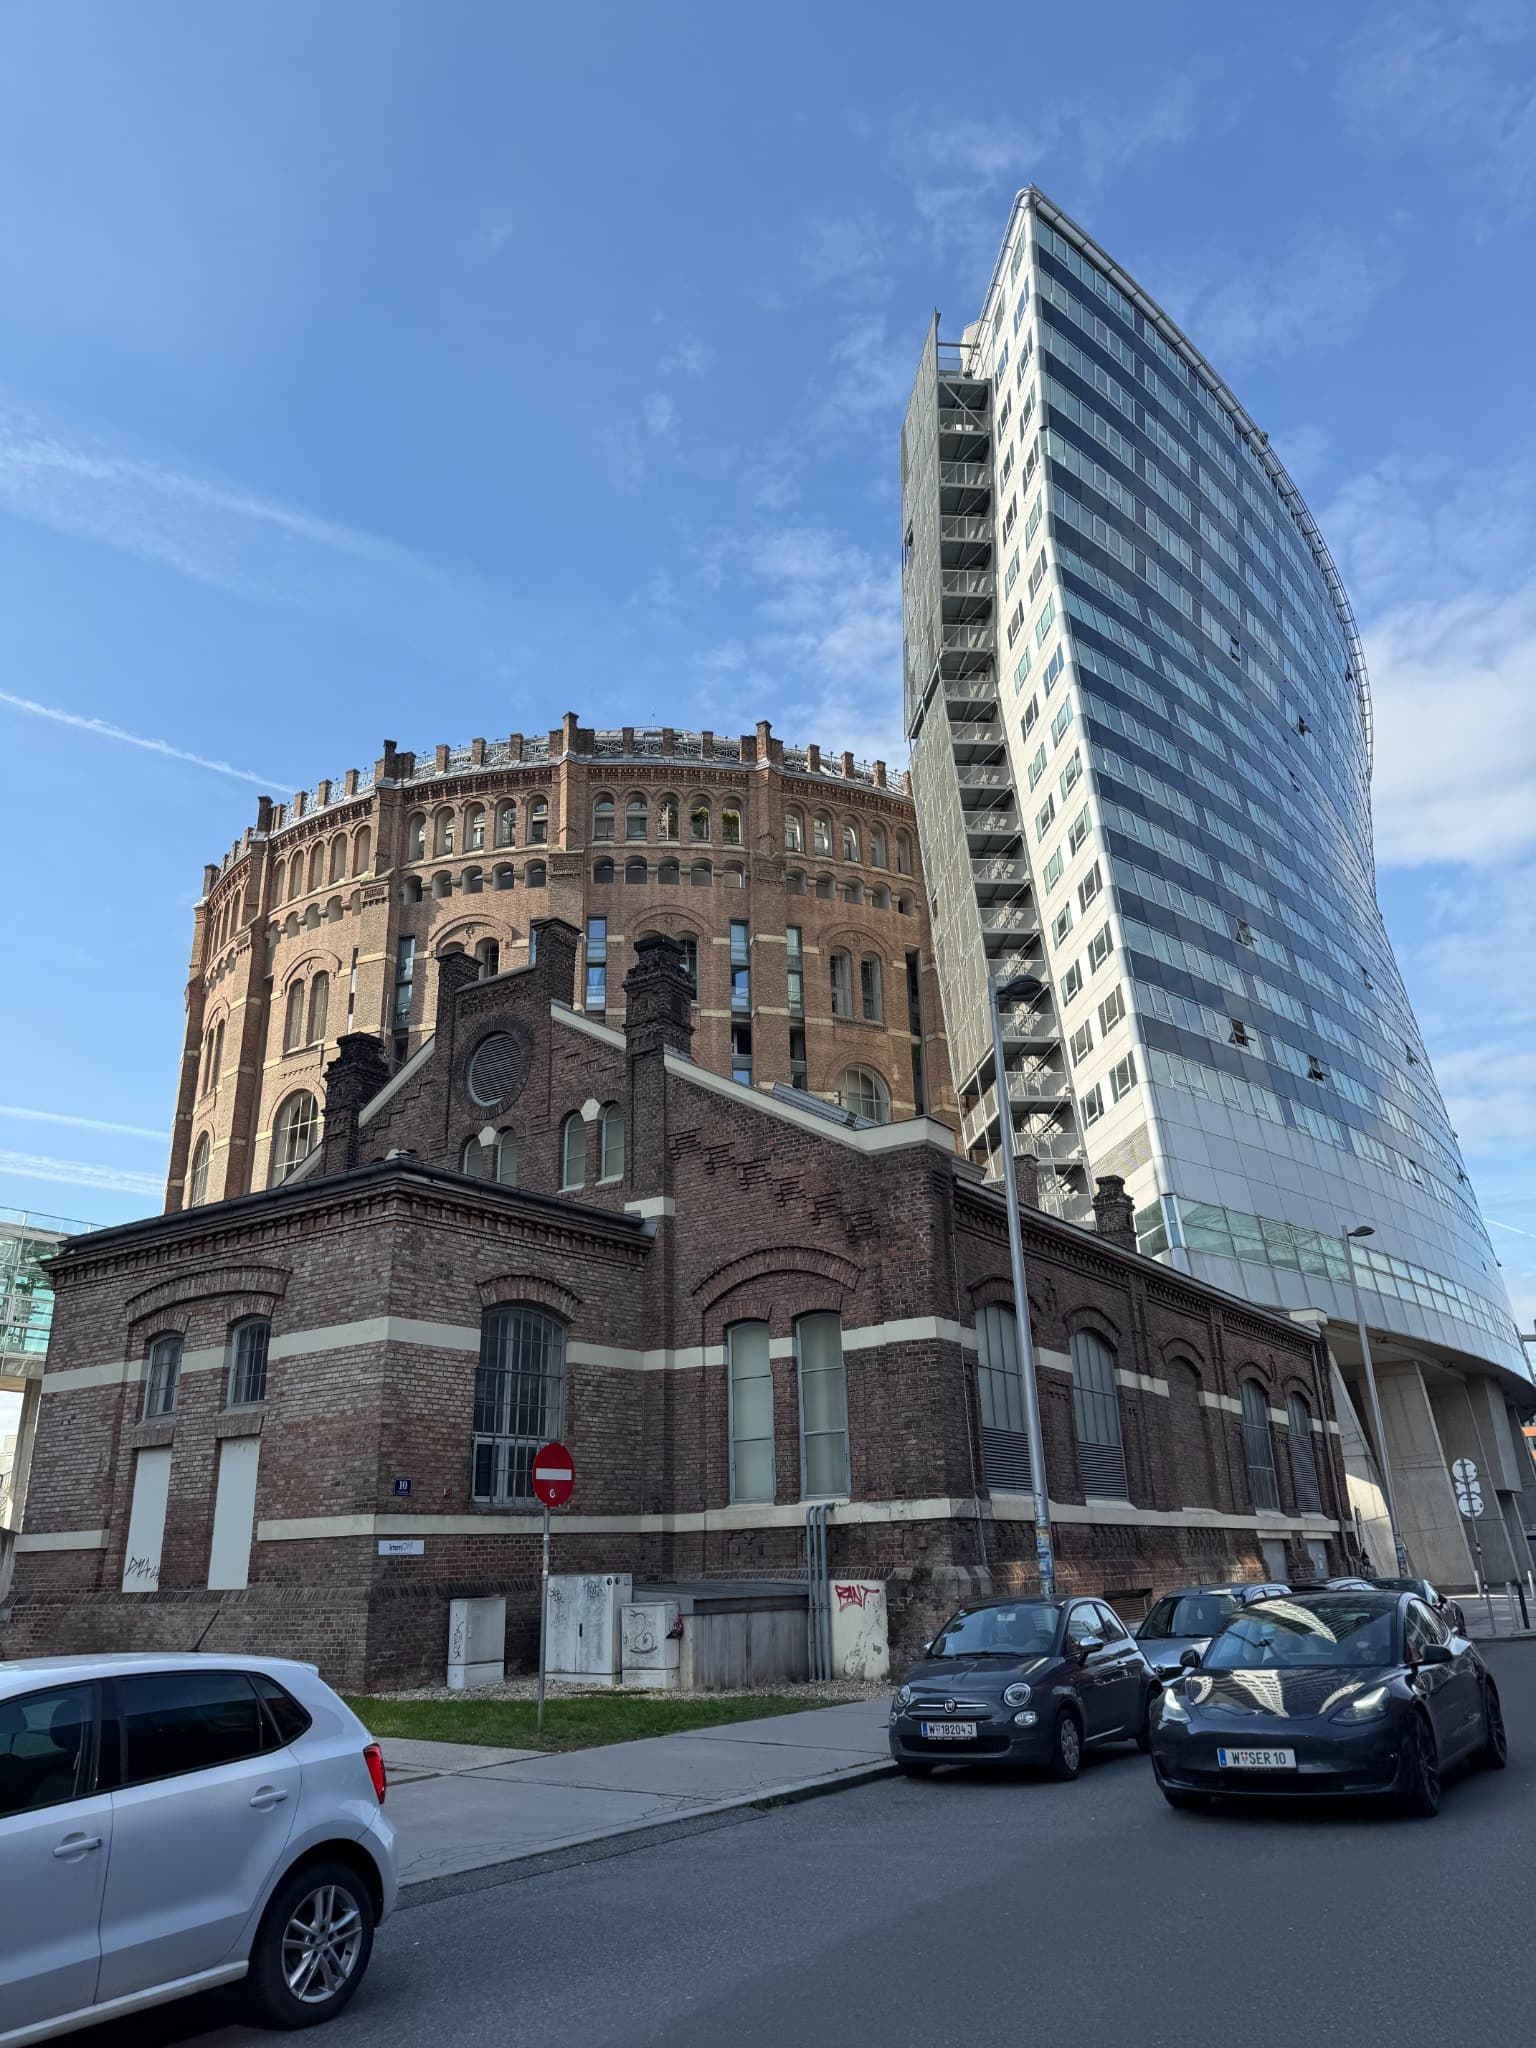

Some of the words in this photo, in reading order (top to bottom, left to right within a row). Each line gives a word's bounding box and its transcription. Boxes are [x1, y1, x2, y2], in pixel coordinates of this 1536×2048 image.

[399, 1480, 408, 1490] 10
[929, 1724, 935, 1735] W
[1231, 1752, 1240, 1765] W
[1248, 1751, 1271, 1765] SER
[1273, 1751, 1287, 1765] 10
